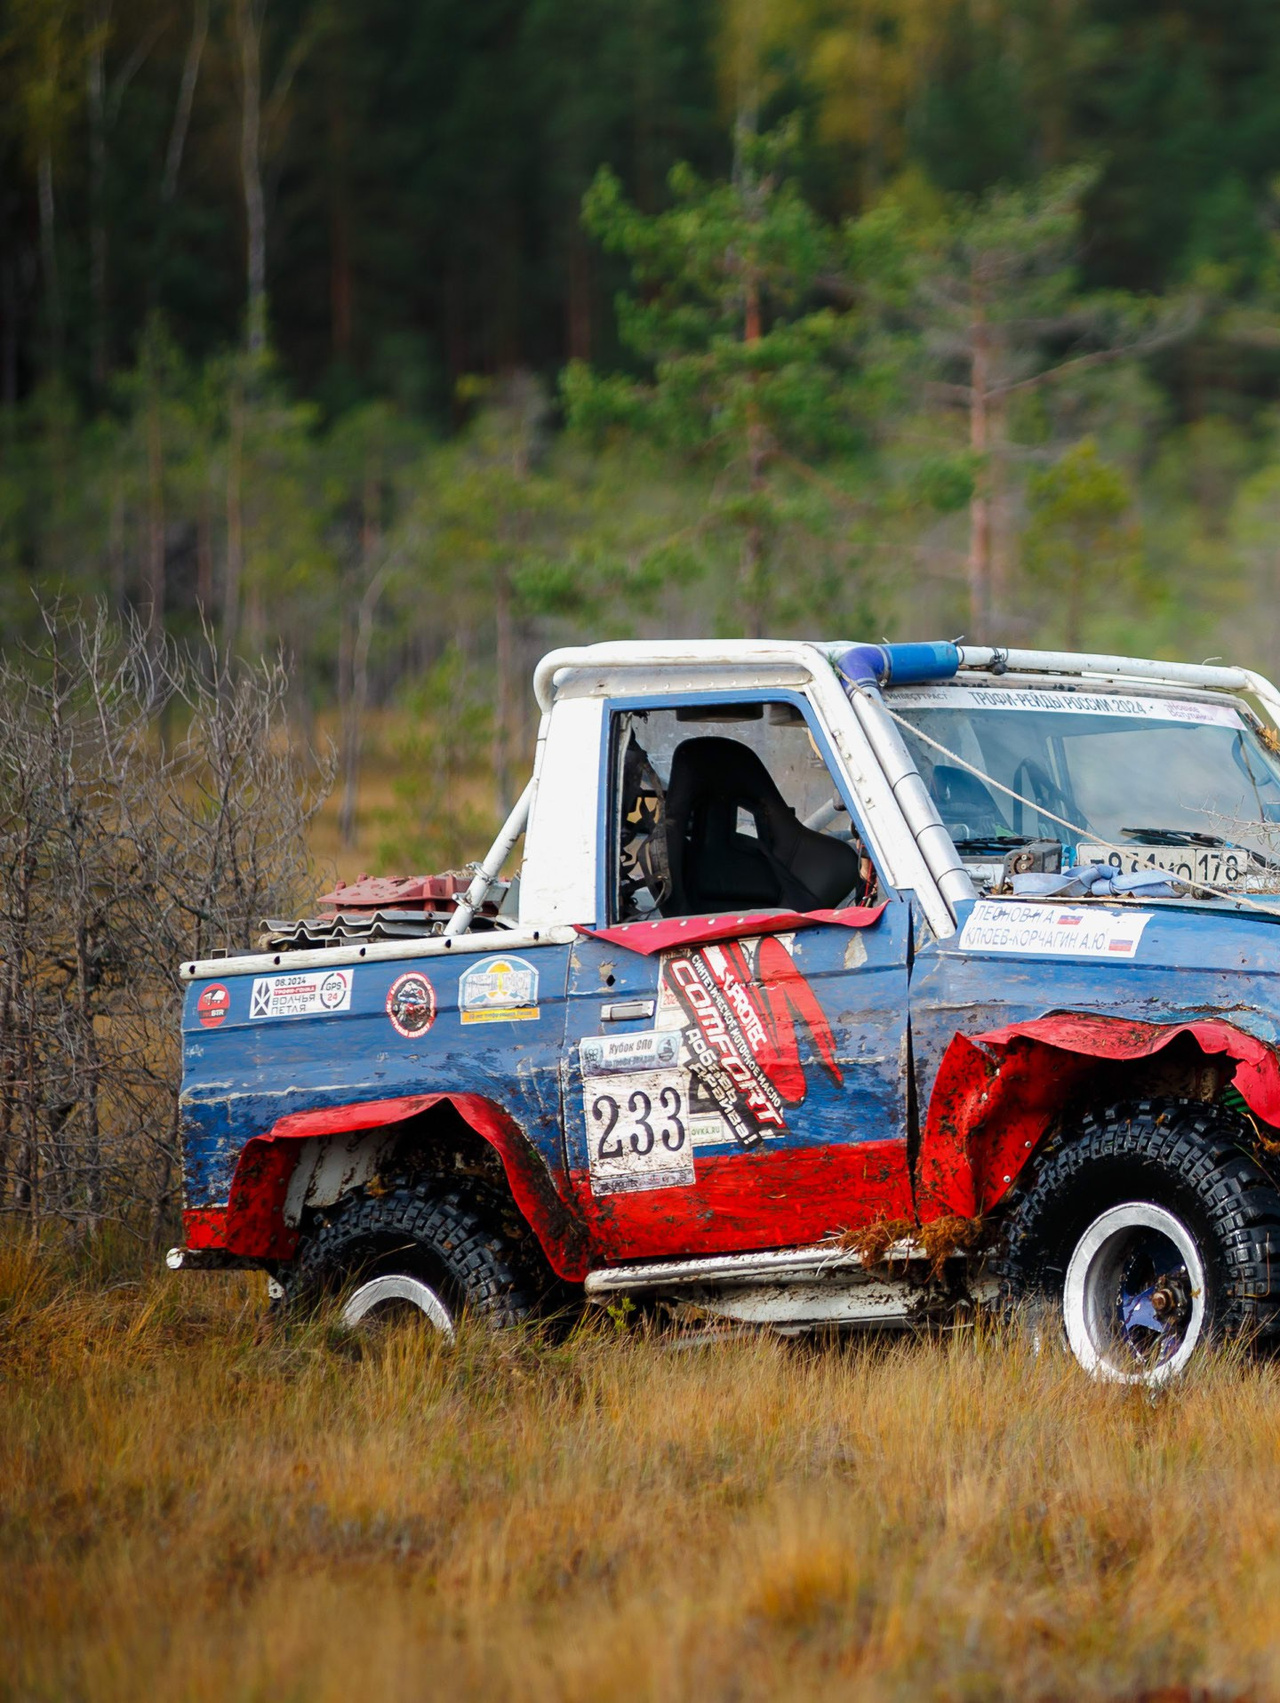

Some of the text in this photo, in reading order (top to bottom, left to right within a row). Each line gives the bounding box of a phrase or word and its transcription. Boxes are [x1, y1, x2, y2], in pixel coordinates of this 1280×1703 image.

[968, 691, 1065, 710] ТРОФИ-РЕЙДЫ
[1062, 696, 1114, 712] РОССИИ
[1198, 854, 1239, 881] 178
[275, 977, 306, 987] 08.2024
[325, 981, 342, 991] GPS
[272, 994, 315, 1006] ВОЛЧЬЯ
[327, 992, 338, 1001] 24
[271, 1004, 306, 1015] ПЕТЛЯ
[691, 954, 738, 1030] СИНТЕТИЧЕСКОЕ
[729, 1027, 762, 1077] МОТОРНОЕ
[756, 1076, 781, 1107] МАСЛО
[609, 1042, 634, 1055] Кубок
[671, 959, 783, 1126] COMFORT
[592, 1086, 685, 1160] 233
